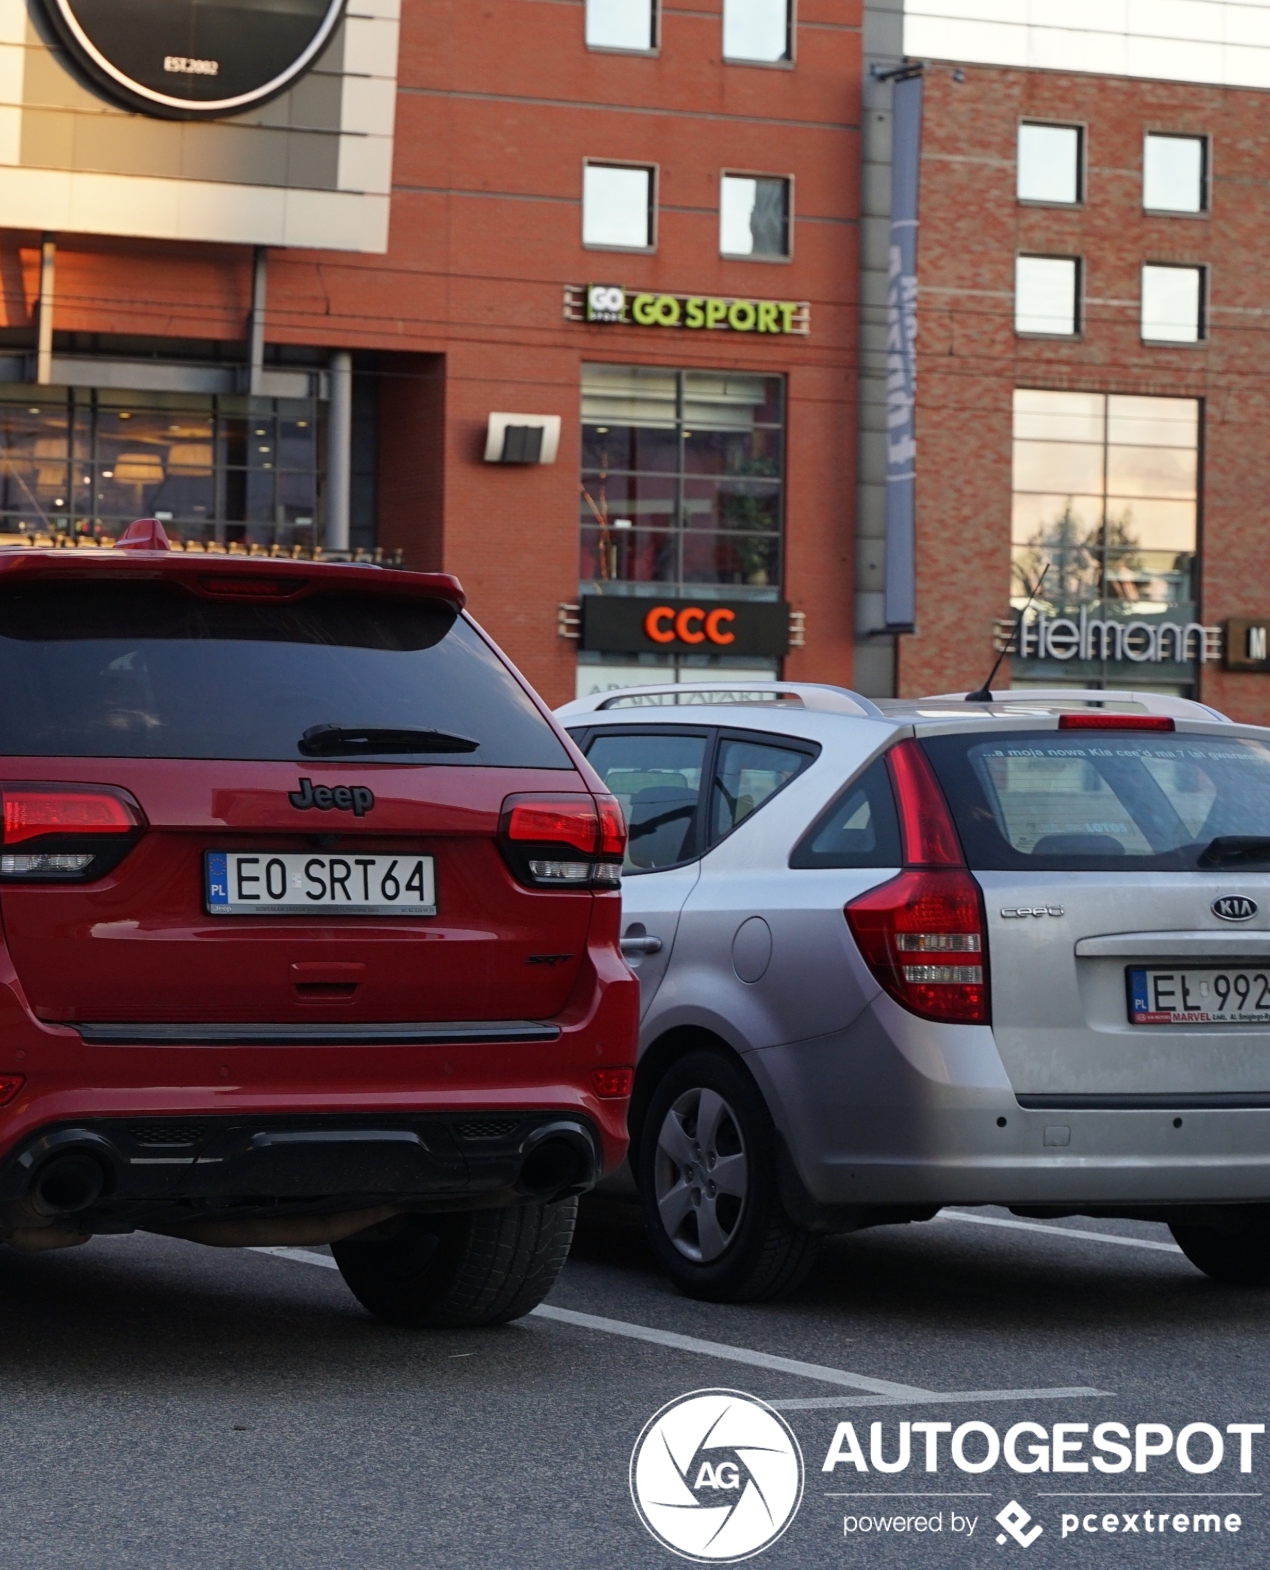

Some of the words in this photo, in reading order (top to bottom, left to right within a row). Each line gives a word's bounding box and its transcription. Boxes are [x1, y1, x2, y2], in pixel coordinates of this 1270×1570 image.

[632, 293, 681, 327] GO
[684, 297, 798, 334] SPORT
[644, 605, 737, 645] CCC
[1007, 748, 1044, 758] moja
[1047, 749, 1086, 757] nowa
[1088, 748, 1113, 757] Kia
[1154, 750, 1177, 758] ma
[288, 777, 375, 818] Jeep
[211, 884, 226, 896] PL
[305, 858, 424, 901] SRT64
[1219, 900, 1252, 915] KIA
[1135, 998, 1147, 1010] PL
[1214, 973, 1270, 1010] 992
[1173, 1012, 1212, 1022] MARVEL
